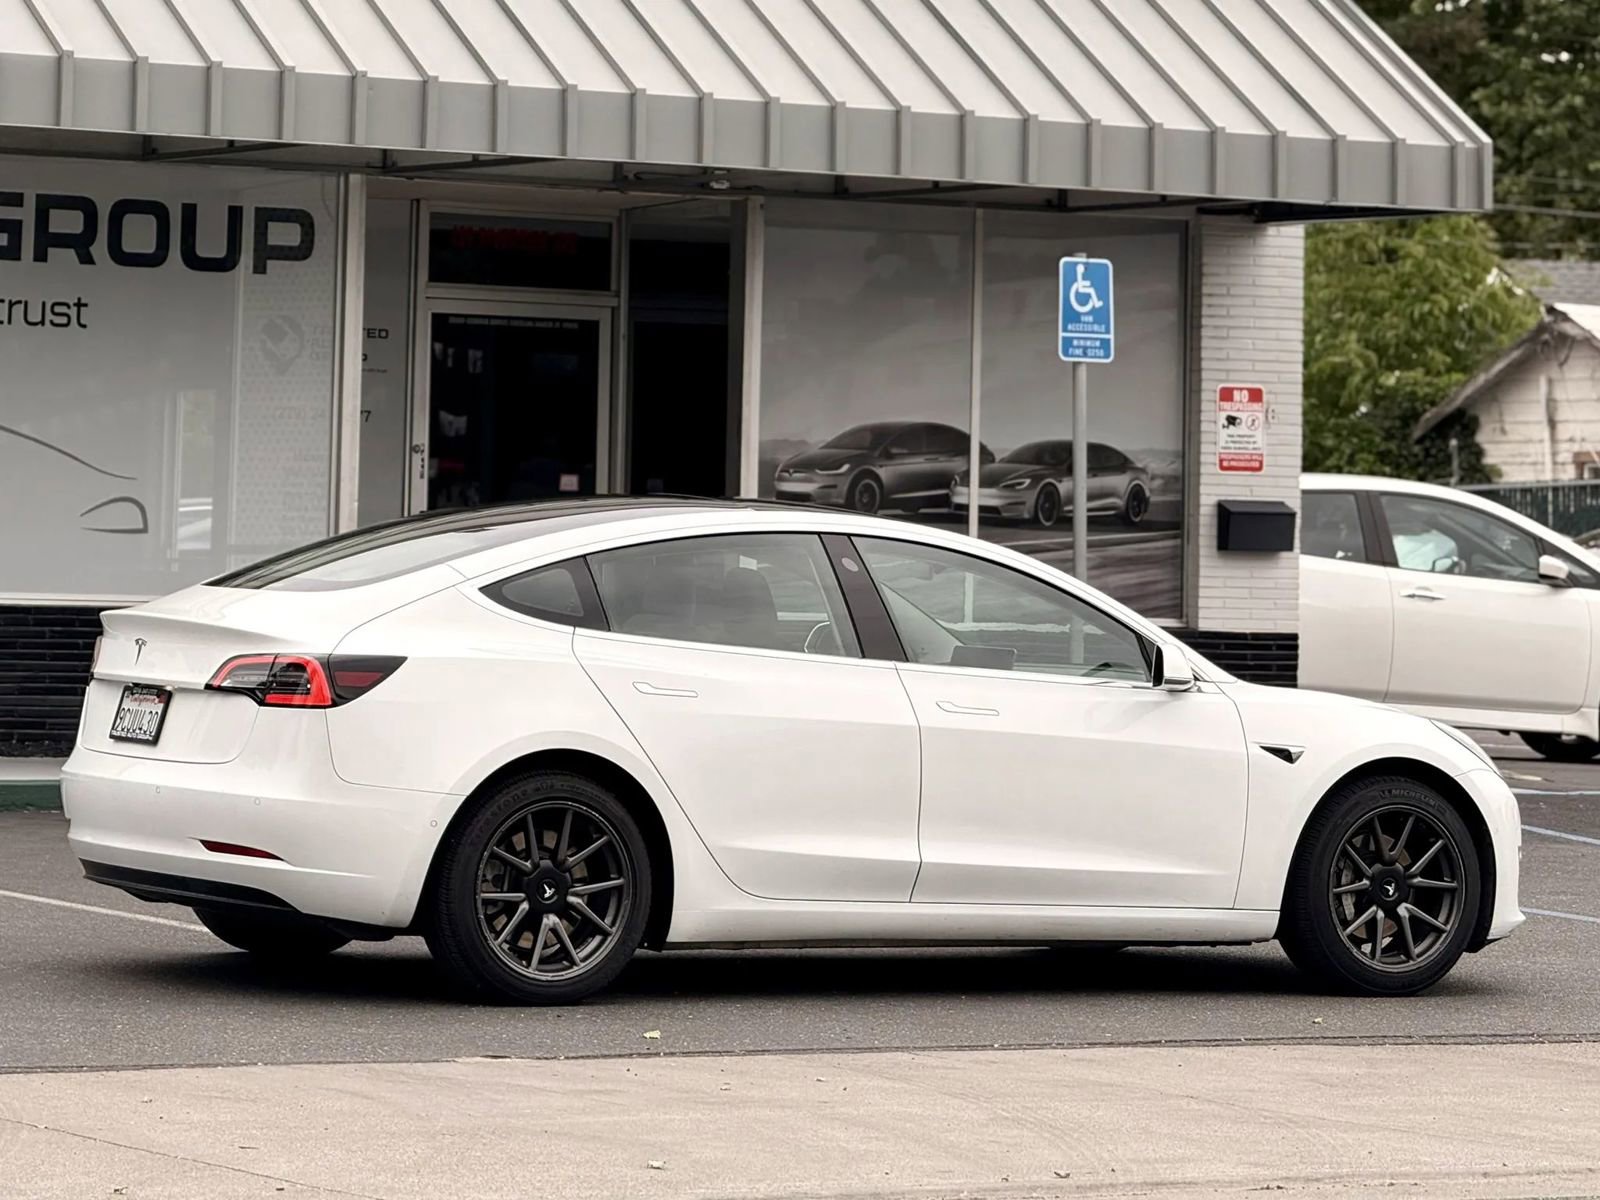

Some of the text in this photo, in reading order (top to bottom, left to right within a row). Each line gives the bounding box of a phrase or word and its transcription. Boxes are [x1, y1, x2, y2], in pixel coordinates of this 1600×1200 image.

[1067, 323, 1105, 332] ACCESSIBLE
[1073, 339, 1101, 347] MINIMUM
[1068, 347, 1084, 355] FINE
[1233, 389, 1249, 402] NO
[1219, 402, 1263, 411] TRESPASSING
